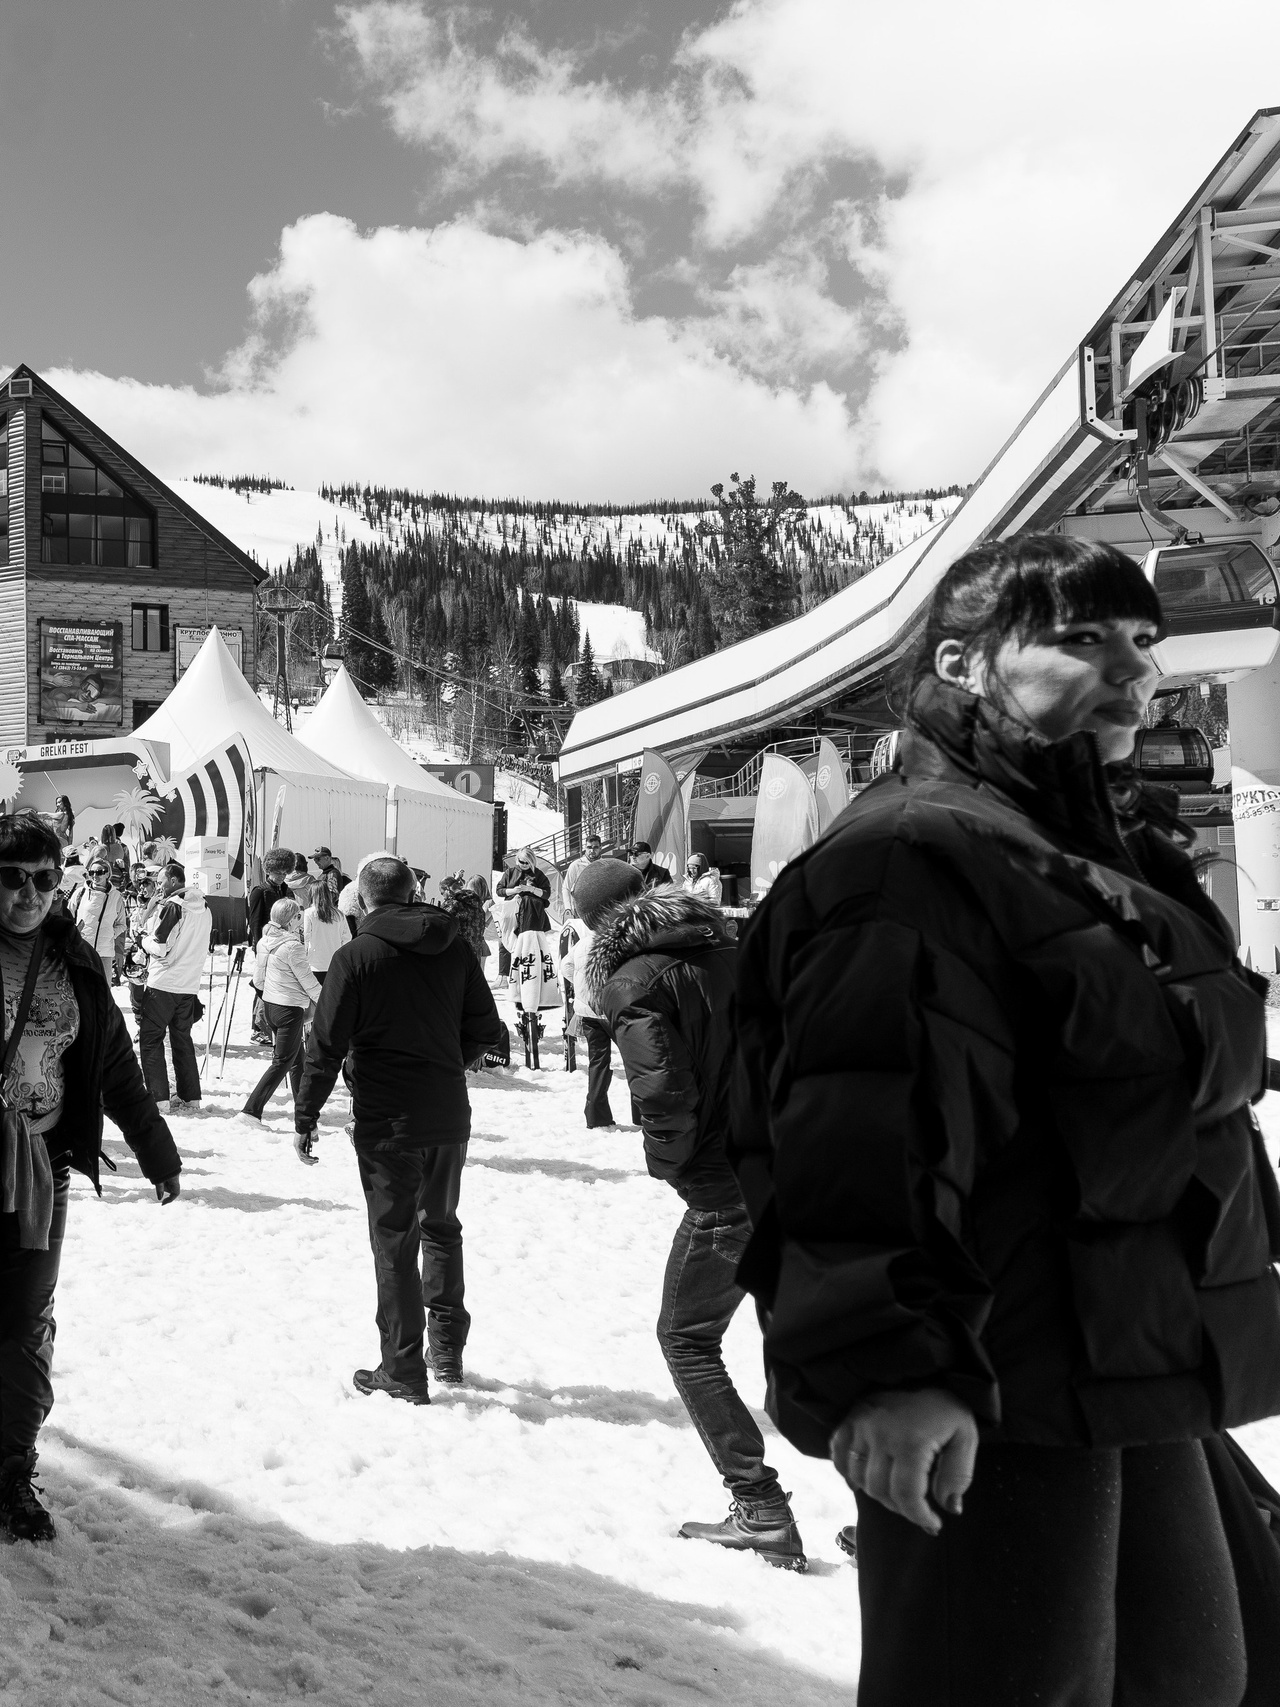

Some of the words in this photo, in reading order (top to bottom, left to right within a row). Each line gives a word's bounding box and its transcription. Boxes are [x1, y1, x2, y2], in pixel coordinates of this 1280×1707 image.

[49, 626, 114, 637] ВОССТАНАВЛИВАЮЩИЙ
[40, 744, 67, 757] GRELKA
[70, 742, 89, 754] FEST
[460, 773, 471, 794] 1
